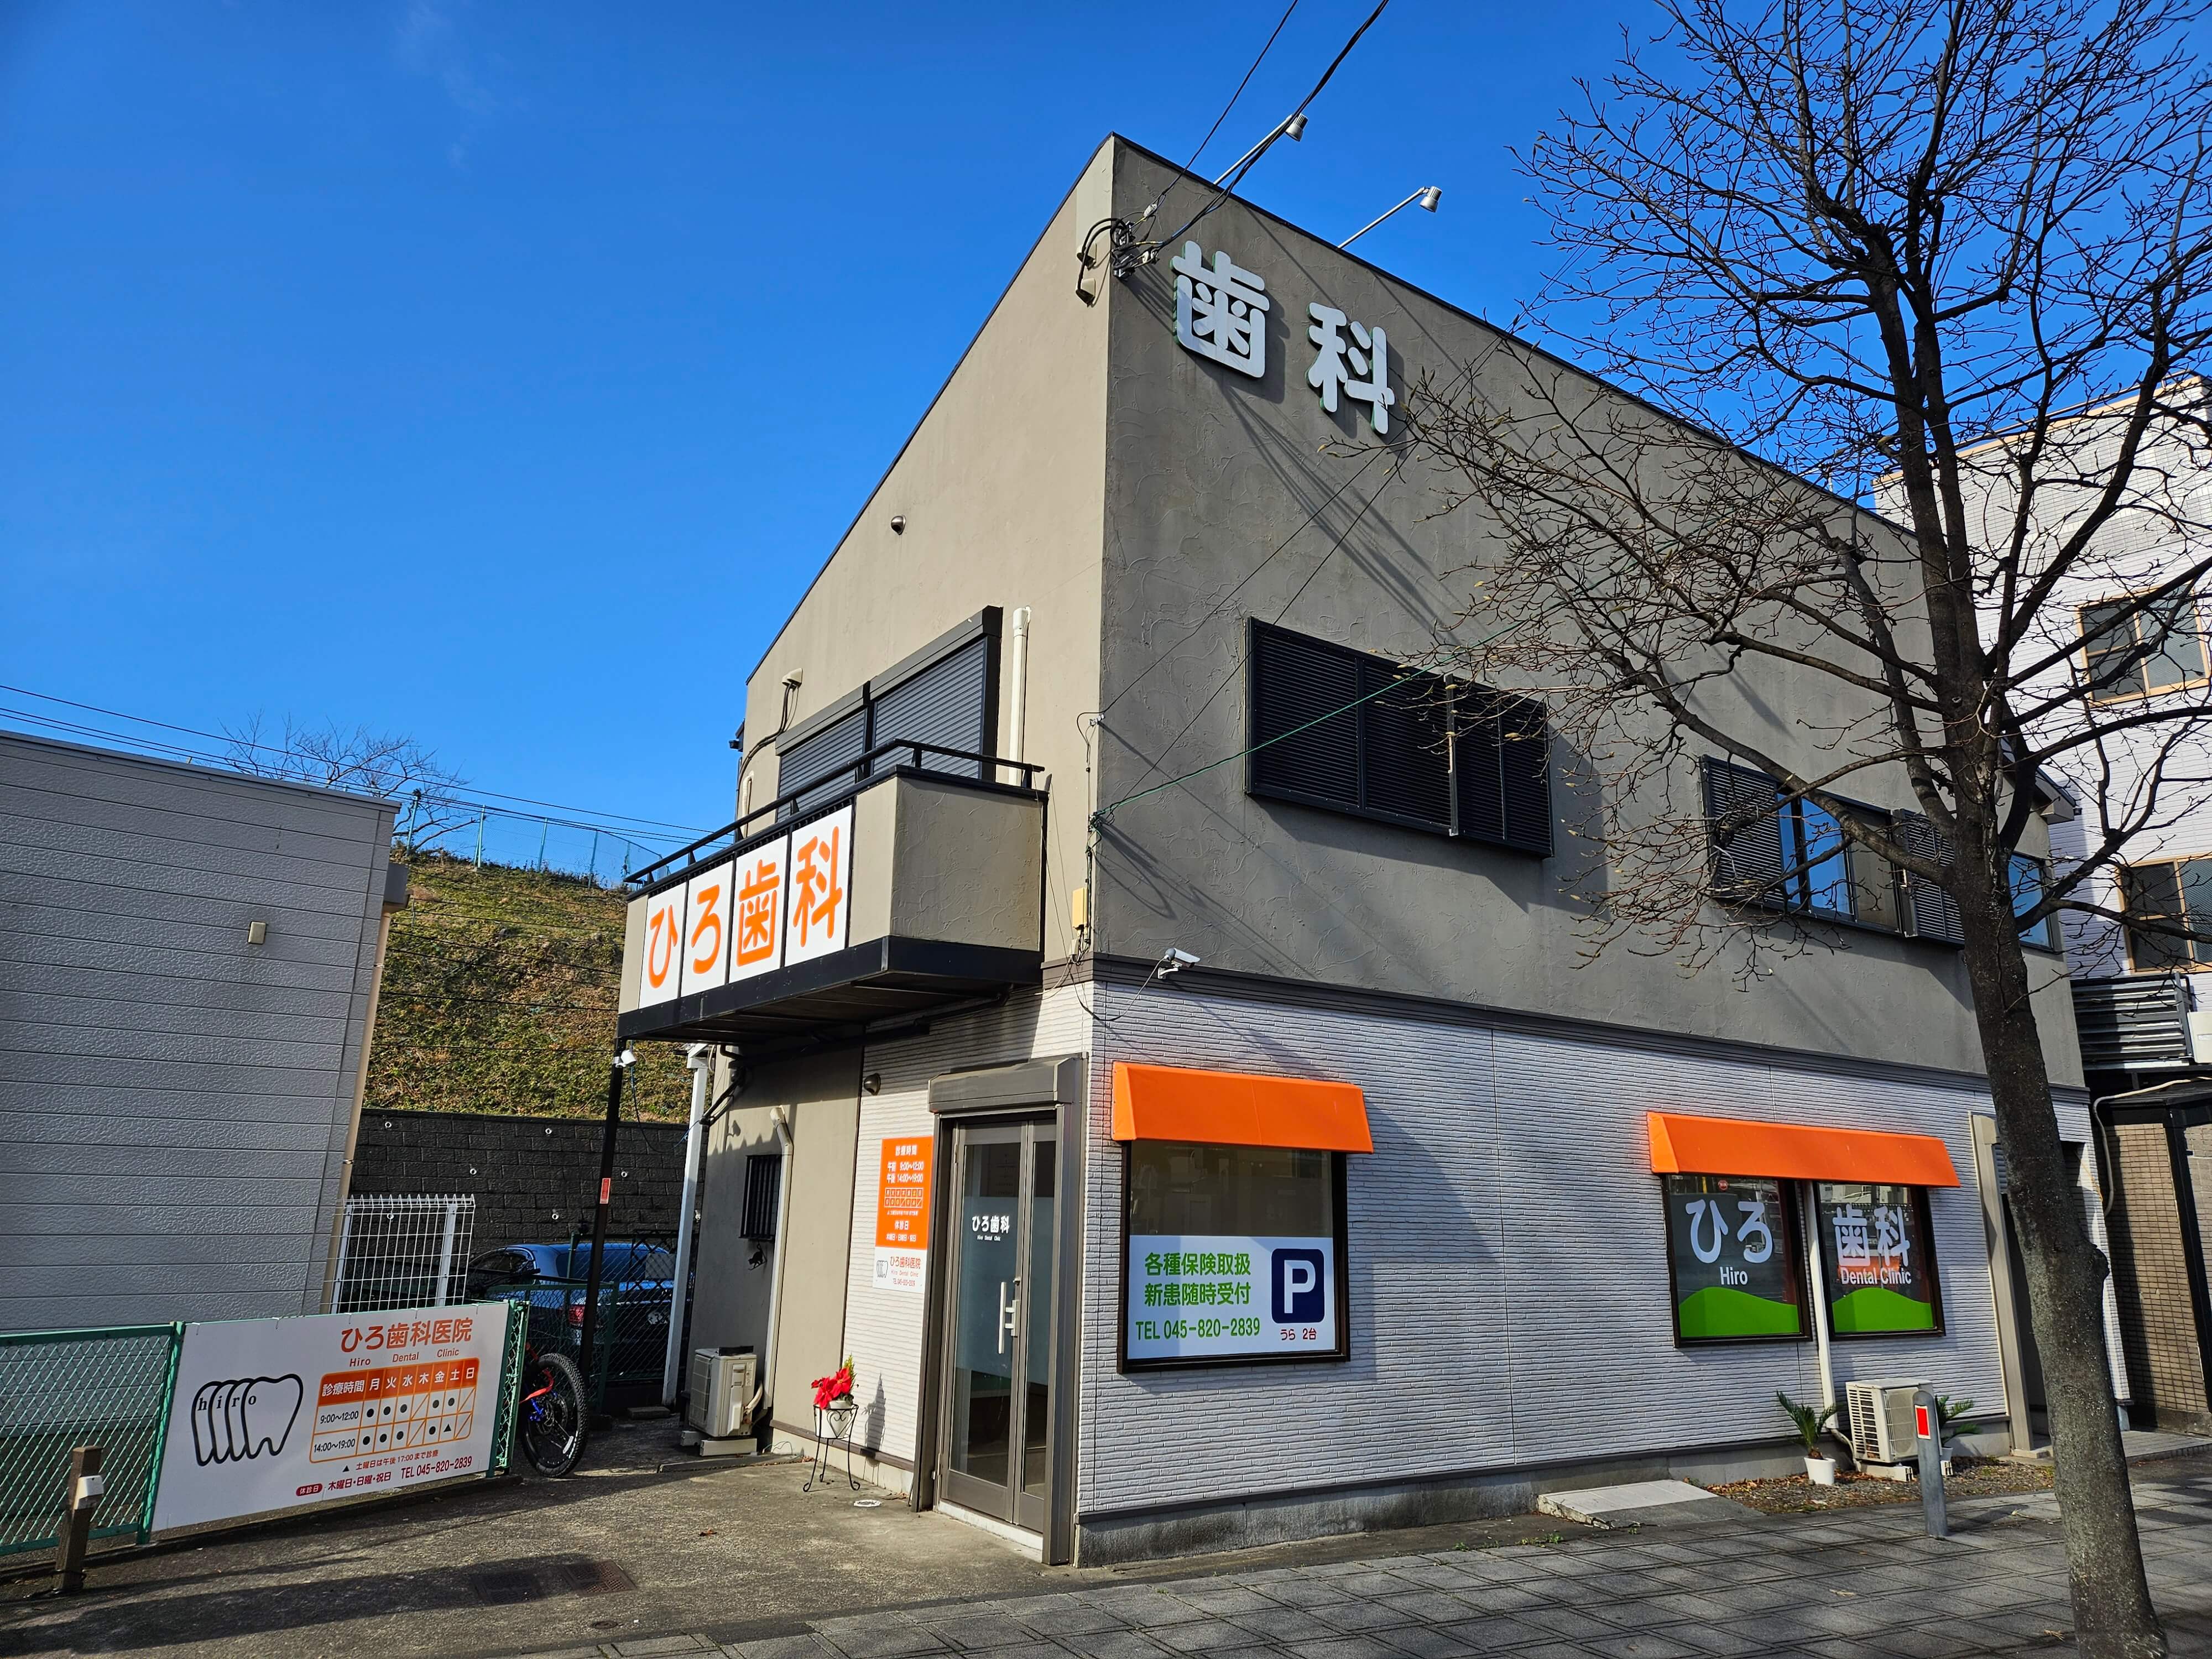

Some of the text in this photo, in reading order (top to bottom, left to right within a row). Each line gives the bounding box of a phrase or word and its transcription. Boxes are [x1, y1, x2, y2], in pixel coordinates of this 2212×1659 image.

[1170, 241, 1395, 435] 歯科
[648, 826, 843, 989] ひろ歯科
[972, 1215, 1010, 1234] ひろ歯科
[1685, 1198, 1773, 1264] ひろ
[1832, 1203, 1910, 1266] 歯科
[890, 1256, 921, 1269] ひろ歯科医院
[1144, 1252, 1251, 1276] 各種保険取扱
[1284, 1260, 1316, 1313] P
[1720, 1266, 1748, 1286] Hiro
[1840, 1266, 1912, 1285] Dental Clinic
[1144, 1282, 1251, 1307] 新患随時受付
[341, 1317, 473, 1353] ひろ歯科医院
[1136, 1317, 1260, 1340] TEL 045-820-2839
[1280, 1328, 1317, 1340] うら 2台
[349, 1348, 459, 1367] Hiro Dental Clinic
[322, 1367, 475, 1397] 診療時間 月 火 水 木 金 土 日
[299, 1485, 319, 1496] 休診日
[401, 1466, 415, 1479] TEL
[416, 1455, 473, 1476] 045-820-2839
